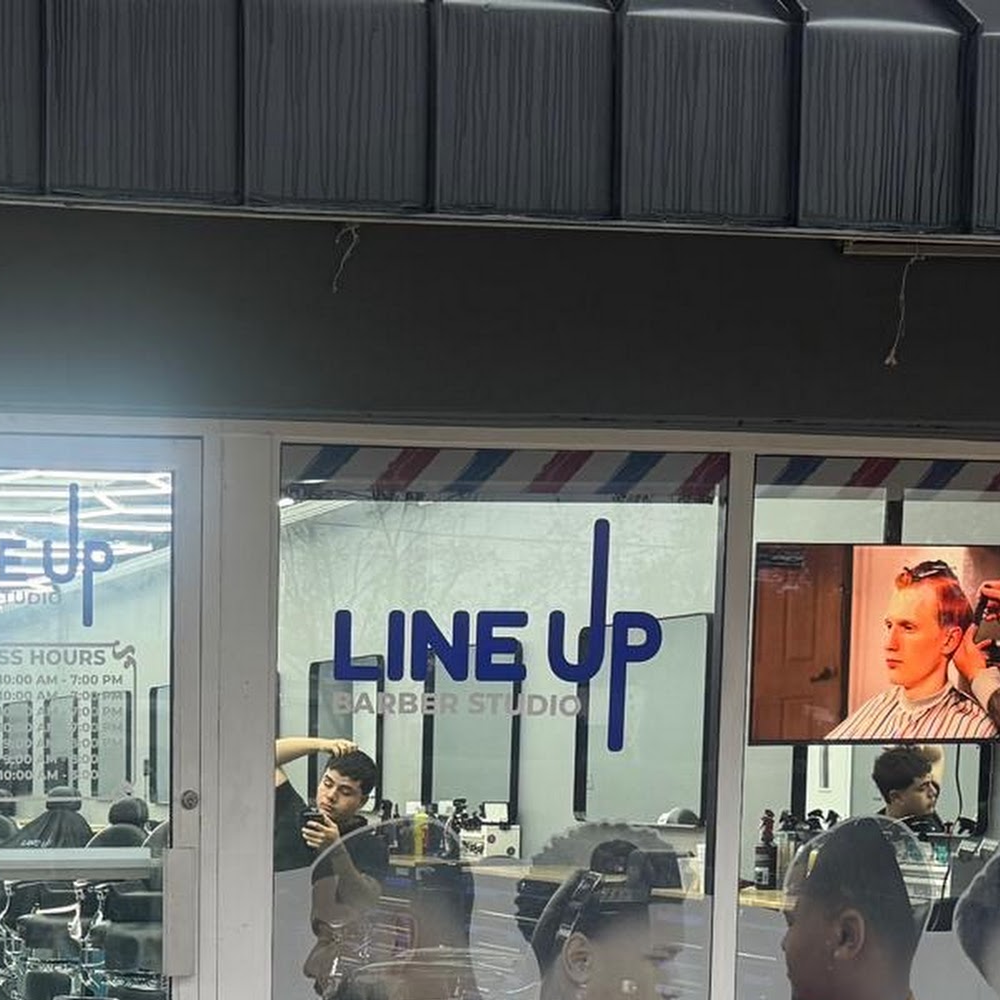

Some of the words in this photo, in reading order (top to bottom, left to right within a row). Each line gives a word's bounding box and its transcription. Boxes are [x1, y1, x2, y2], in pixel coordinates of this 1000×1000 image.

[43, 482, 114, 627] UP
[333, 609, 528, 682] LINE
[547, 518, 663, 752] UP
[30, 648, 107, 666] HOURS
[36, 674, 58, 685] AM
[70, 674, 99, 686] 7:00
[102, 674, 123, 686] PM
[331, 691, 459, 715] BARBER
[467, 692, 583, 717] STUDIO
